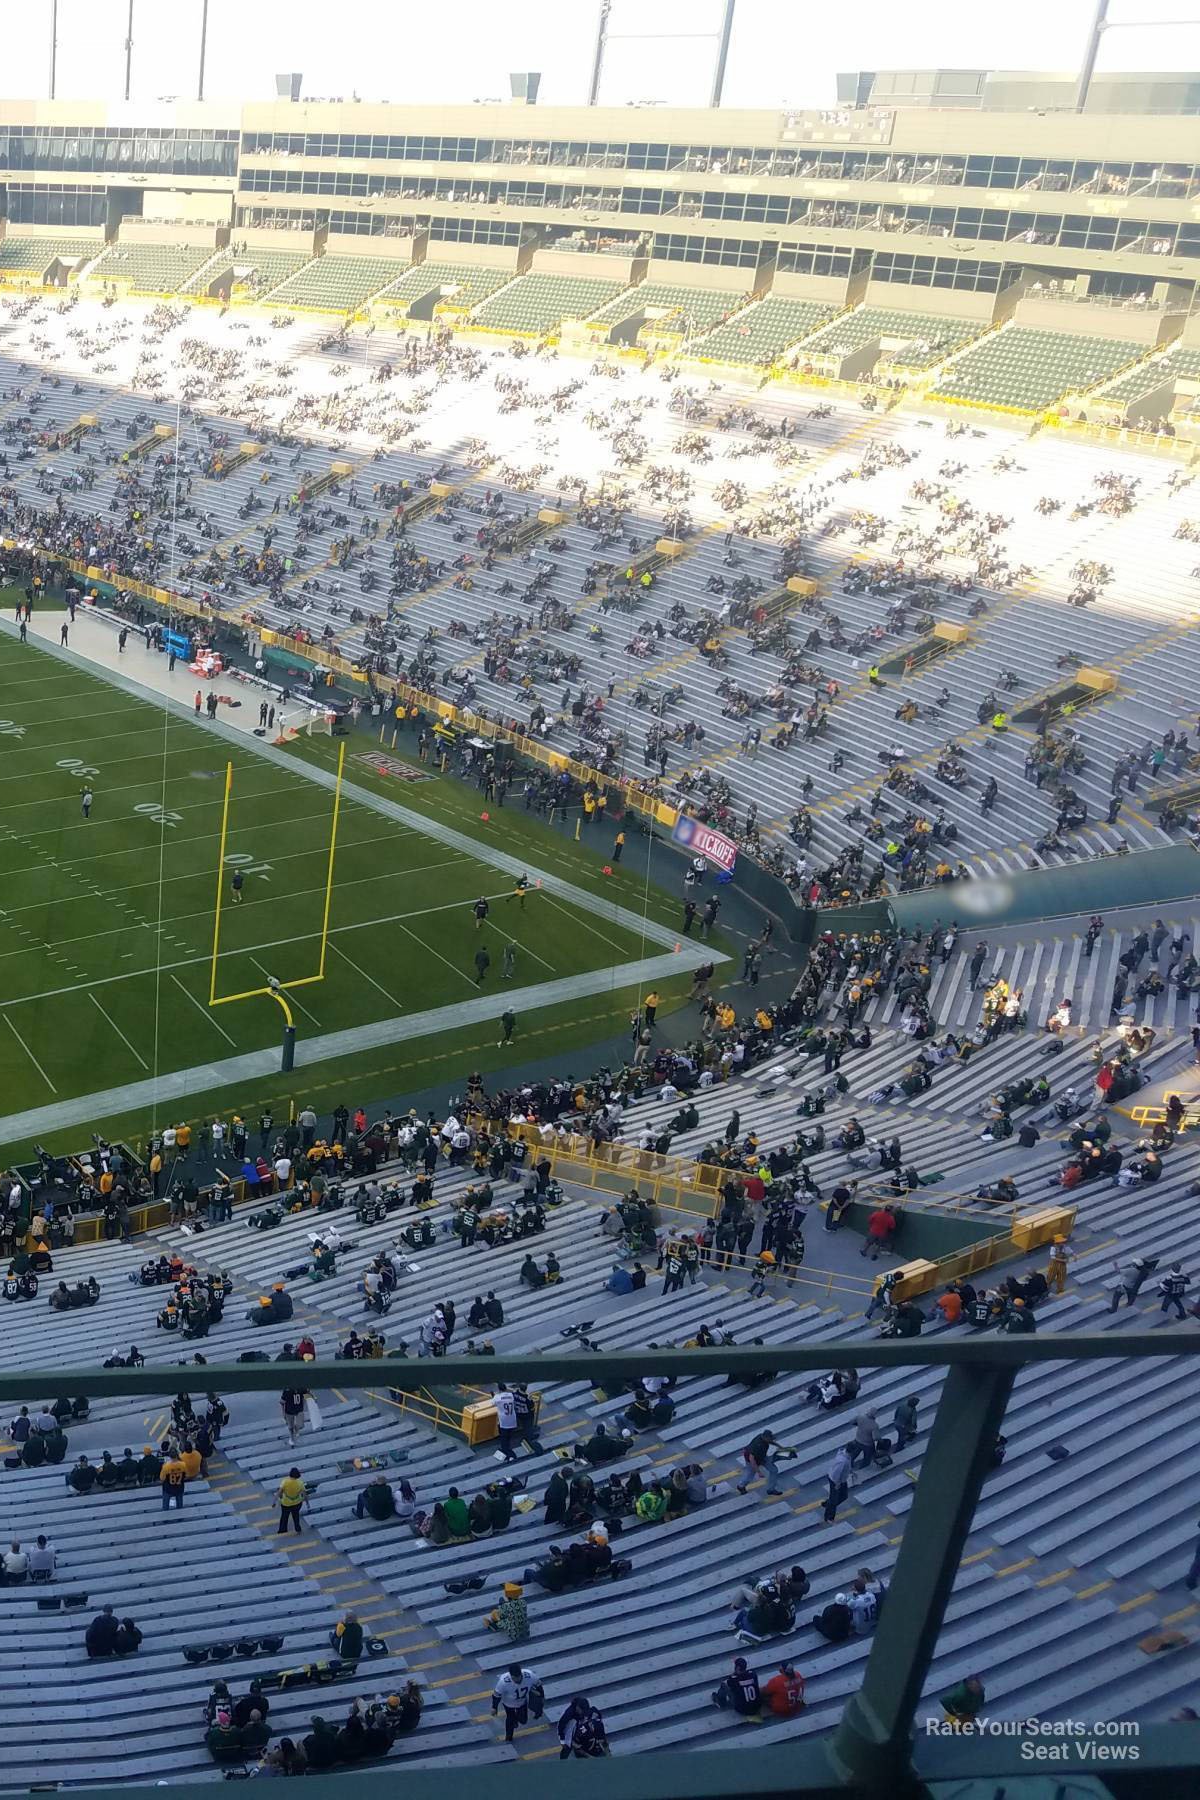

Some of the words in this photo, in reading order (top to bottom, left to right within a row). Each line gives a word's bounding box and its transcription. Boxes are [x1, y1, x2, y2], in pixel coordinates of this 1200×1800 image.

[56, 758, 98, 777] 30
[134, 803, 176, 820] 20
[693, 831, 735, 864] KICKOFF
[224, 853, 272, 871] 10
[975, 1309, 987, 1320] 12
[514, 1687, 529, 1699] 17
[744, 1686, 756, 1702] 10
